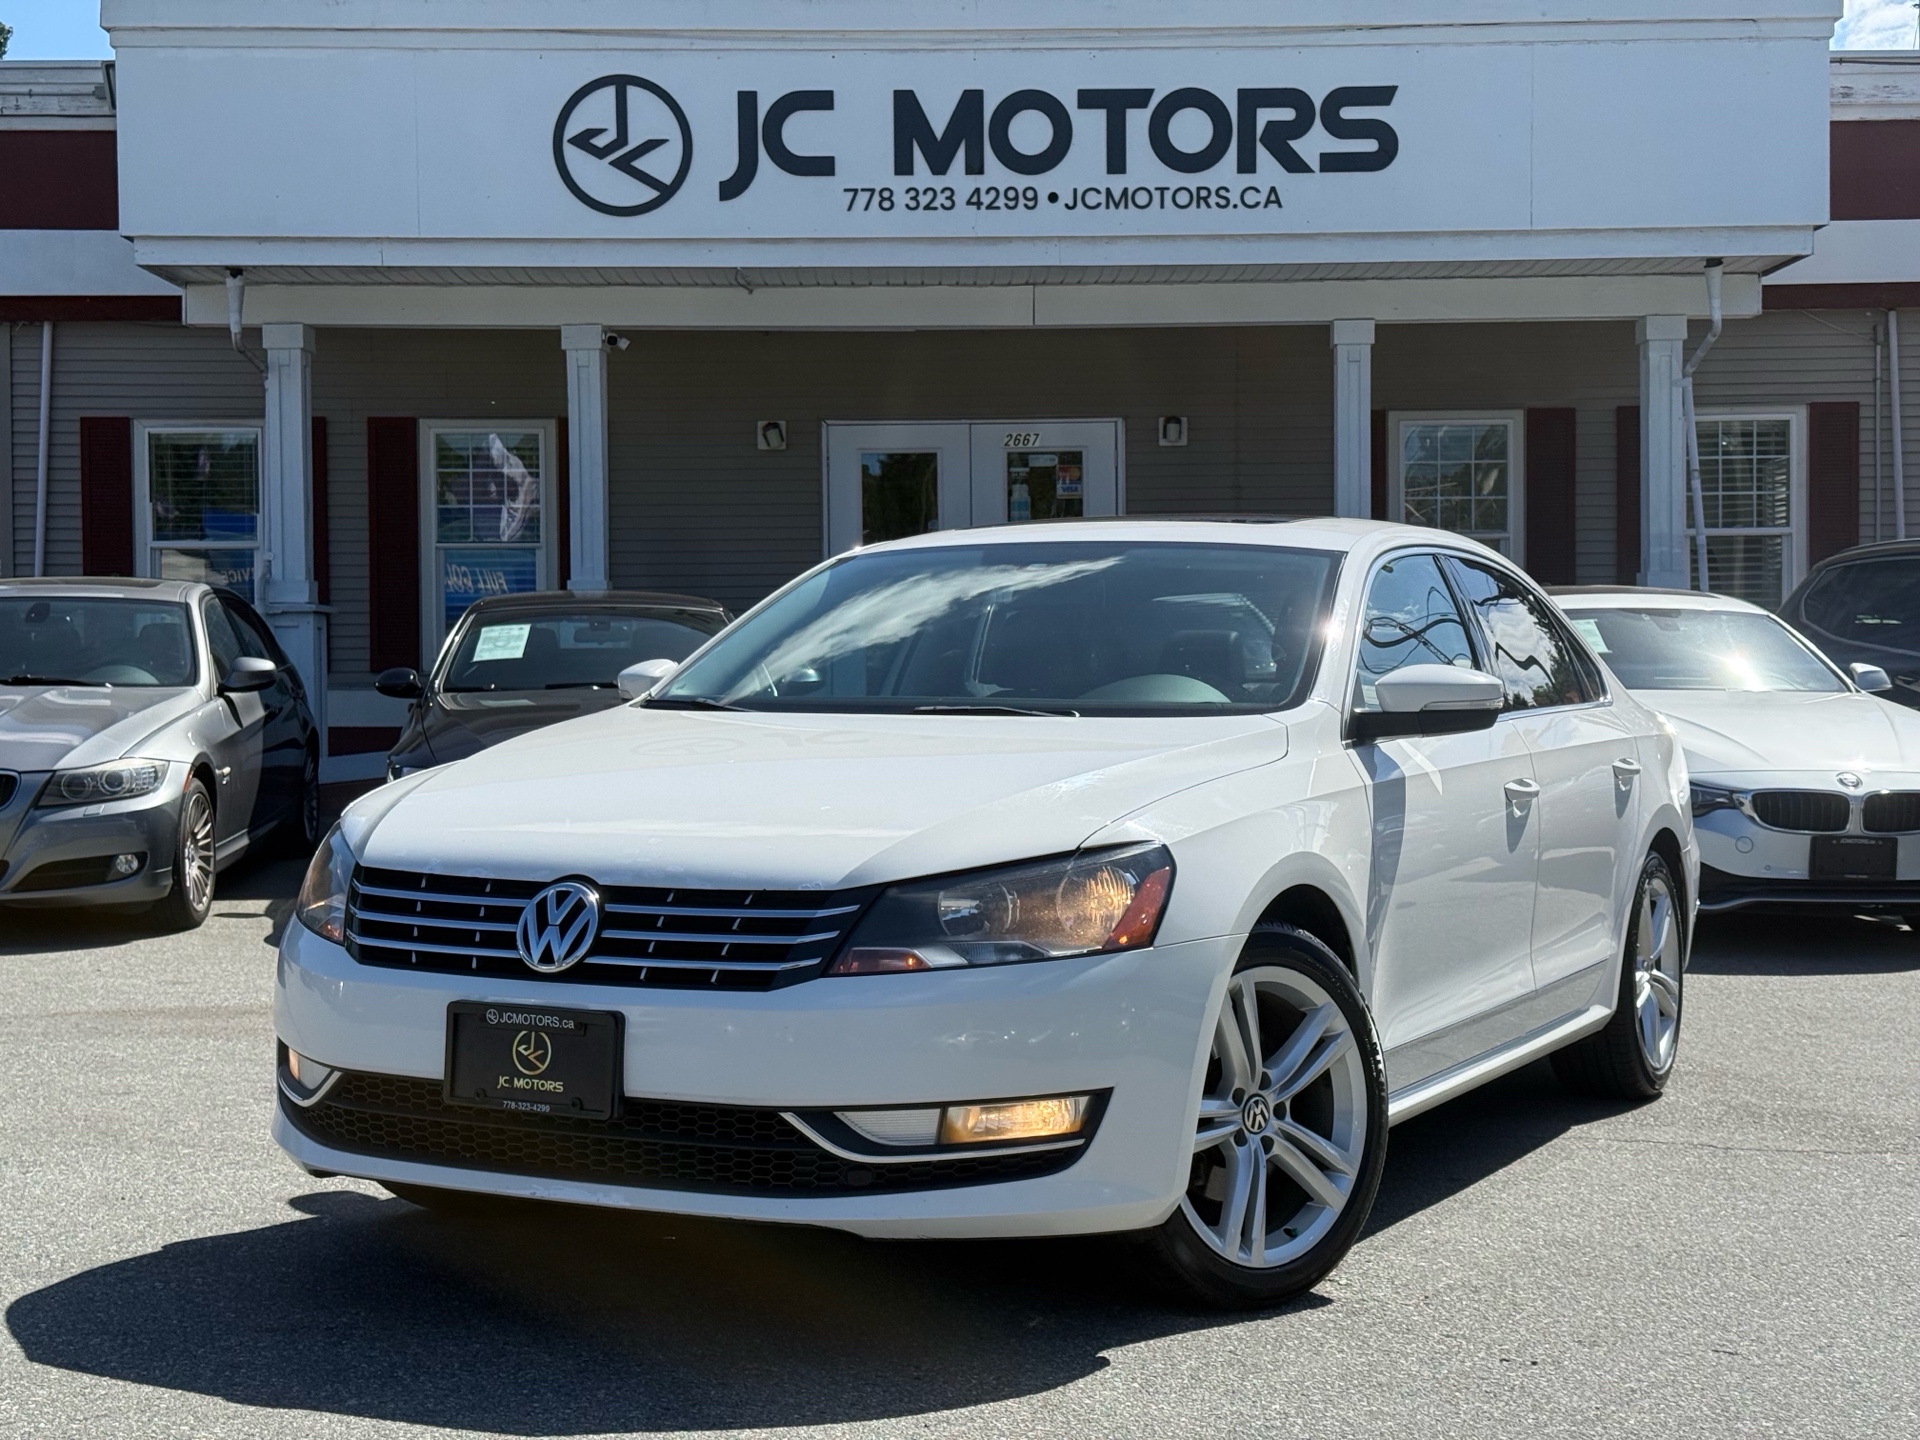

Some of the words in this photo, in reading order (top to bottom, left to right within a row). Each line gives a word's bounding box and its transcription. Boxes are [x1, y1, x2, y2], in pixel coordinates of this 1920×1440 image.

[718, 89, 836, 203] JC
[892, 85, 1400, 177] MOTORS
[842, 186, 896, 212] 778
[904, 186, 956, 212] 323
[965, 185, 1039, 211] 4299
[1063, 185, 1283, 211] JCMOTORS.CA
[1004, 433, 1040, 447] 2667
[500, 1012, 575, 1030] JCMOTORS.ca
[513, 1077, 564, 1093] MOTORS
[502, 1100, 551, 1113] 778-323-4299
